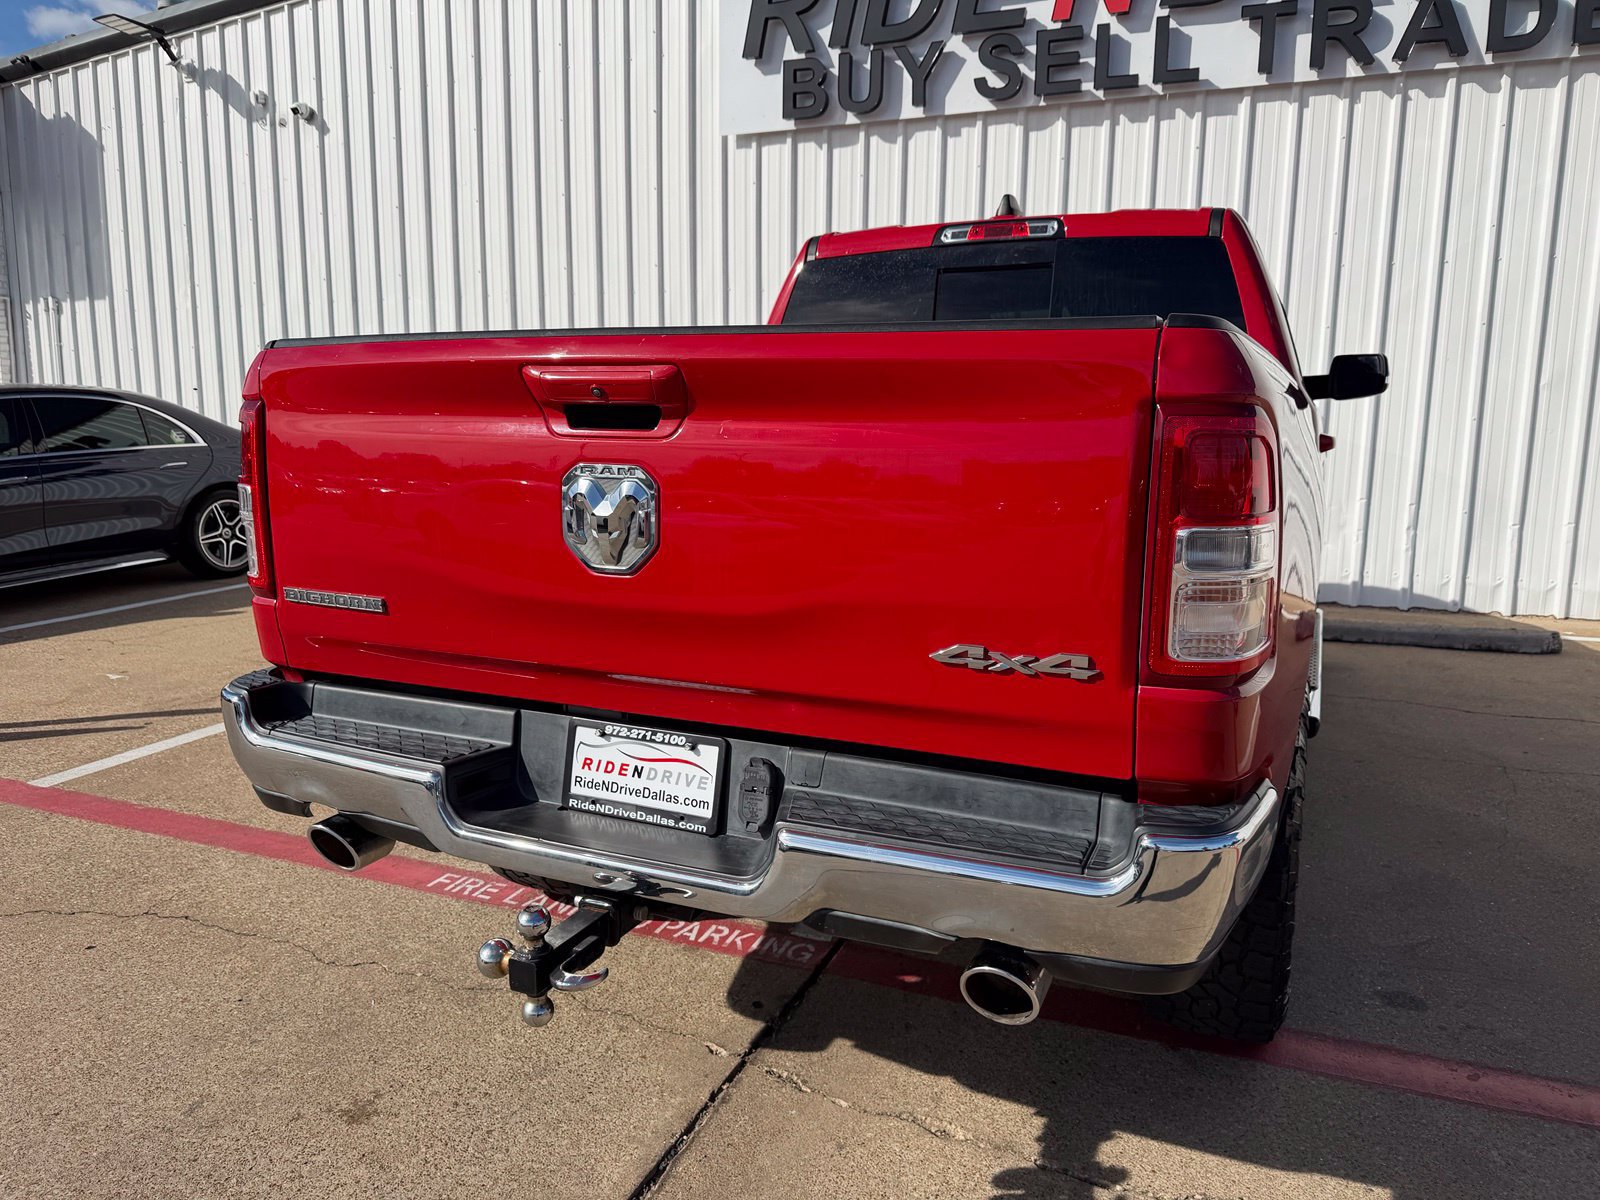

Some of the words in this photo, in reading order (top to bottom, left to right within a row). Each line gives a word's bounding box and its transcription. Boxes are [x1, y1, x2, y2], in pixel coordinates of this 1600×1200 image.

[782, 40, 946, 119] BUY
[974, 15, 1200, 101] SELL
[579, 465, 636, 476] RAM
[283, 587, 384, 613] BIGHORN
[604, 724, 687, 746] 972-271-5100
[581, 756, 710, 791] RIDENDRIVE
[574, 775, 711, 811] RideNDriveDallas.com
[568, 798, 708, 834] RideNDriveDallas.com
[427, 873, 506, 900] FIRE
[503, 887, 579, 916] LAN
[654, 921, 816, 963] PARKING
